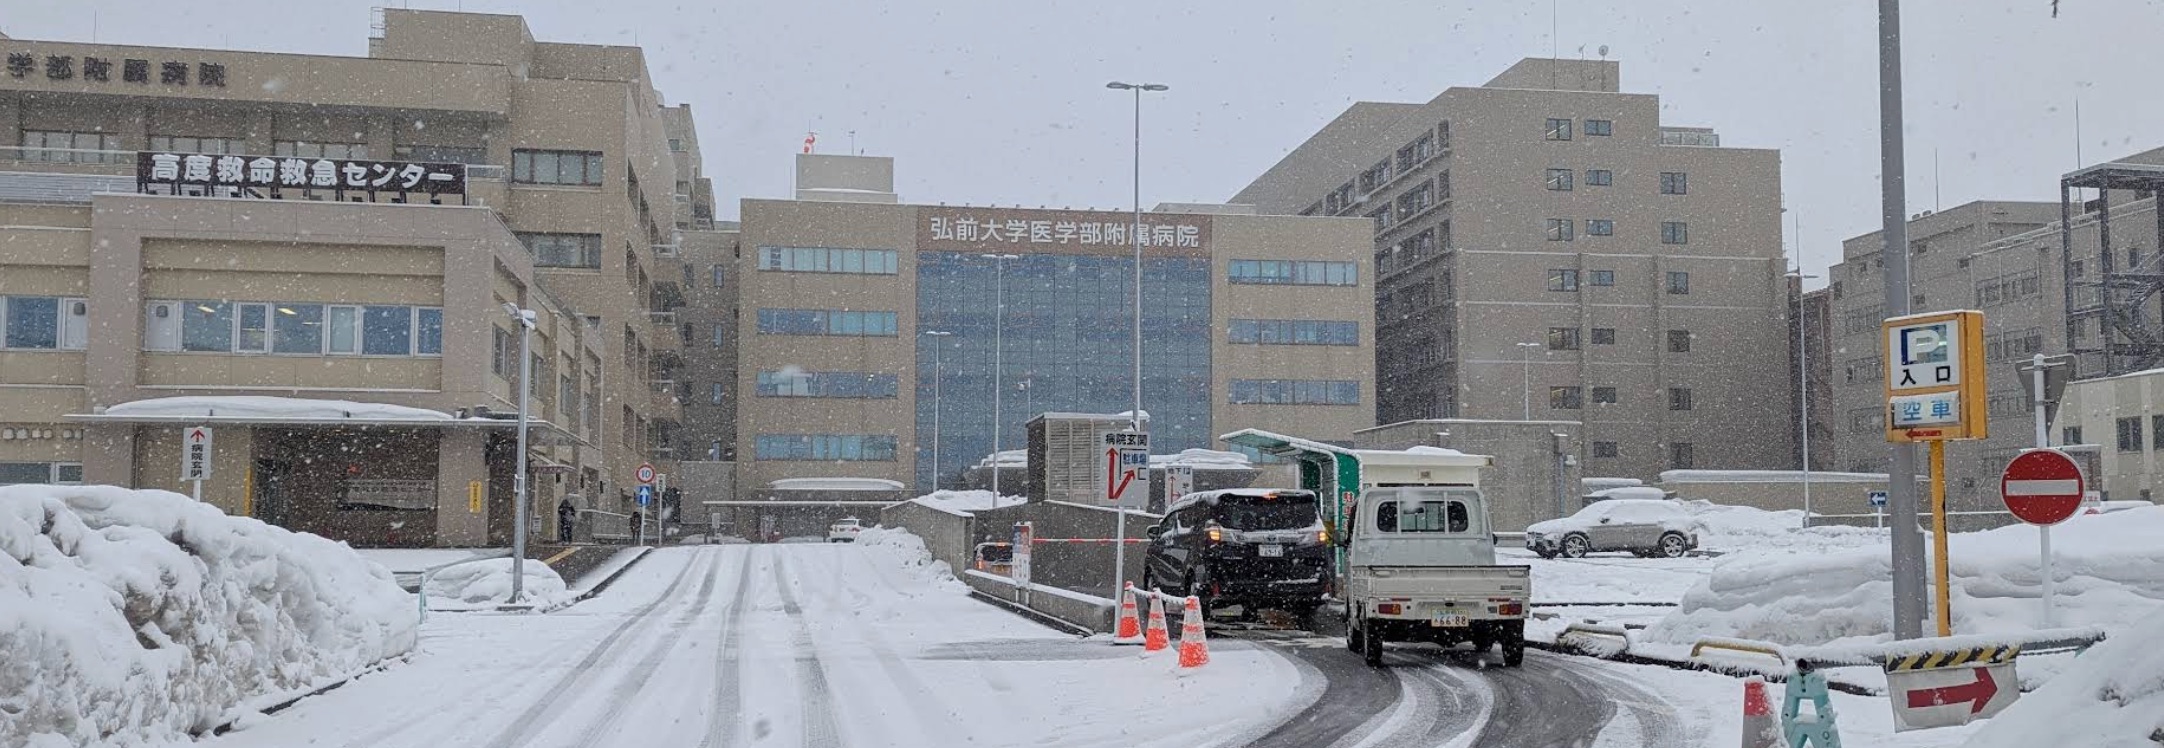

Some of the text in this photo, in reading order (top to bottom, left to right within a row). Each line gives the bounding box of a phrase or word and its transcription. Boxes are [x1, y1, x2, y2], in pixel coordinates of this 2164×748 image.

[151, 153, 454, 189] 高度救命救急センター
[930, 216, 1199, 248] 弘前大学医学部附属病院
[1906, 329, 1941, 362] P
[1900, 366, 1951, 386] 入口
[1903, 400, 1951, 420] 空車
[1106, 433, 1148, 446] 病院玄関
[191, 444, 204, 478] 病院玄関
